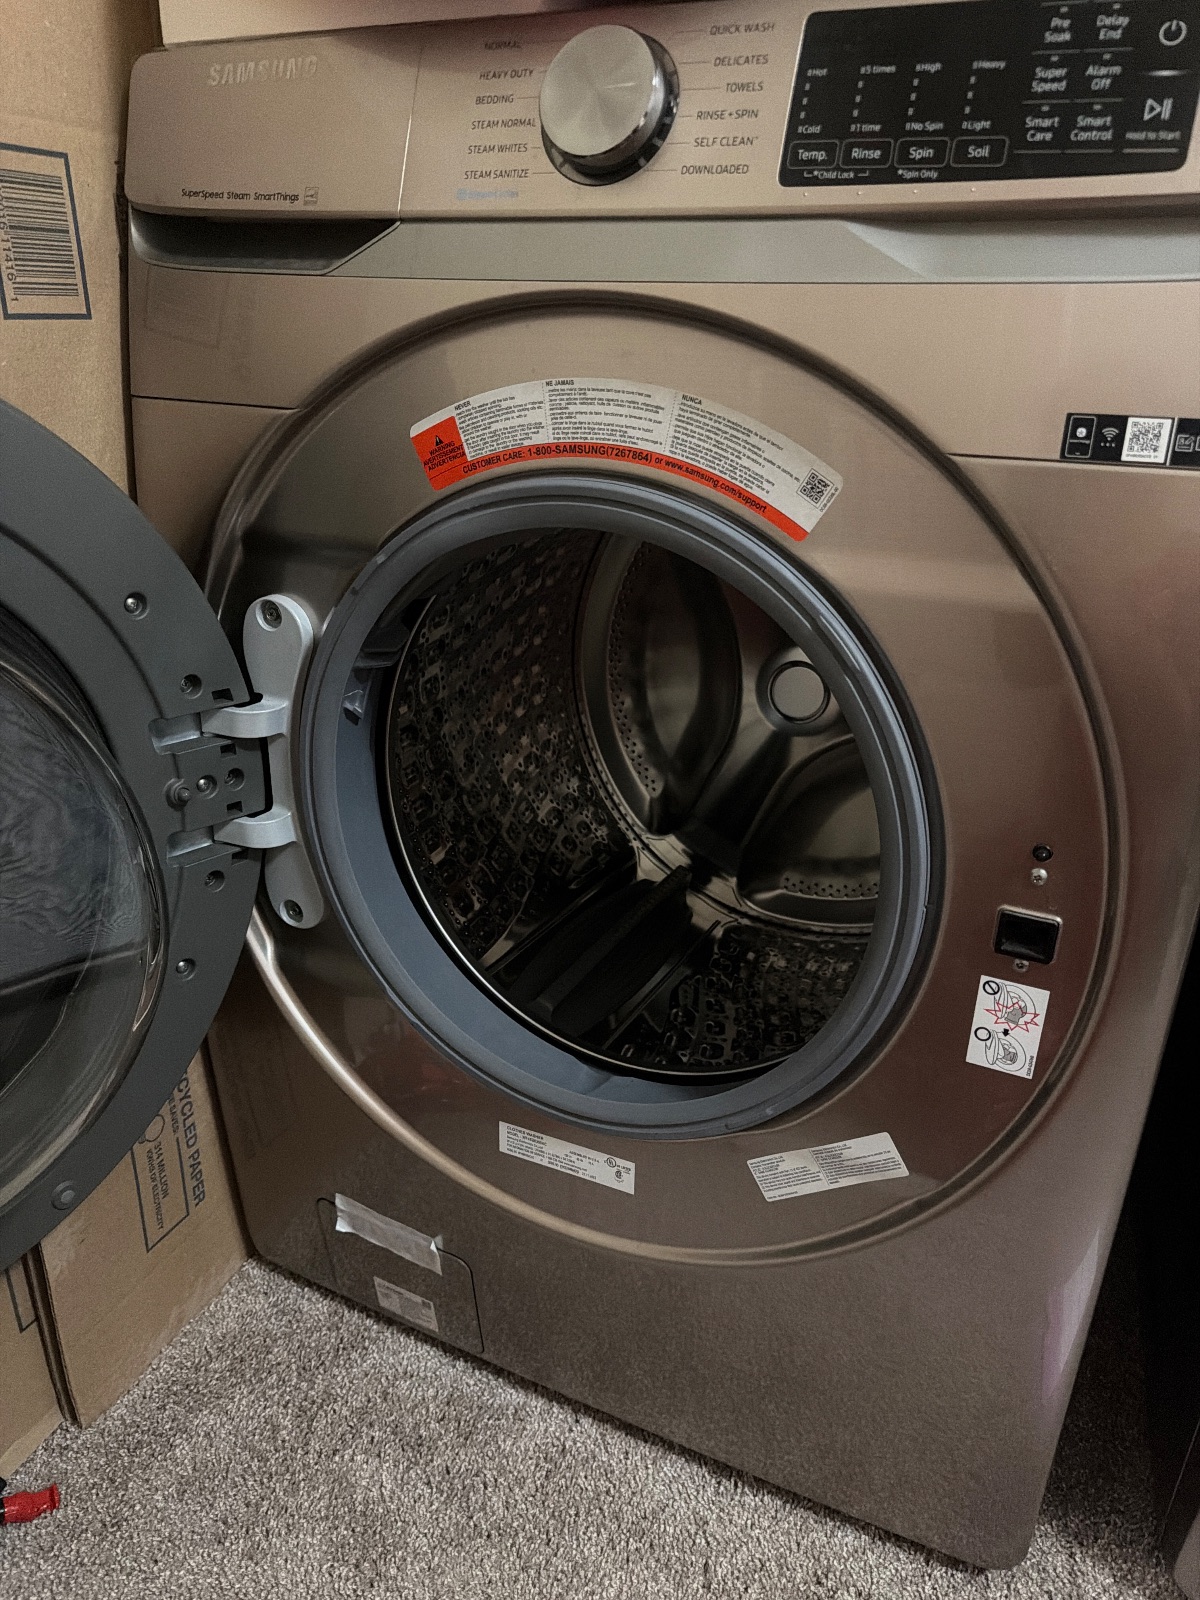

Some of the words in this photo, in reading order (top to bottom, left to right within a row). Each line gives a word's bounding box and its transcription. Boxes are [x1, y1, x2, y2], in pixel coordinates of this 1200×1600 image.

[1050, 17, 1071, 29] Pre
[1096, 14, 1130, 28] Delay
[709, 24, 741, 36] QUICK
[744, 22, 775, 33] WASH
[1099, 27, 1123, 41] End
[1044, 30, 1071, 43] Soak
[484, 41, 521, 51] NORMAL
[713, 53, 769, 67] DELICATES
[479, 70, 508, 80] HEAVY
[509, 68, 534, 79] DUTY
[1034, 66, 1068, 79] Super
[1085, 64, 1122, 76] Alarm
[726, 80, 764, 93] TOWELS
[1031, 79, 1067, 93] Speed
[1090, 77, 1113, 91] Off
[475, 94, 514, 105] BEDDING
[696, 109, 727, 120] RINSE
[734, 109, 759, 120] SPIN
[471, 120, 500, 130] STEAM
[500, 118, 537, 128] NORMAL
[862, 123, 882, 132] time
[911, 122, 923, 131] No
[924, 121, 944, 132] Spin
[967, 120, 992, 132] Light
[1025, 116, 1060, 128] Smart
[1076, 115, 1112, 128] Smart
[802, 125, 821, 134] Cold
[1026, 130, 1054, 142] Care
[1070, 128, 1113, 142] Control
[467, 144, 496, 155] STEAM
[497, 142, 528, 153] WHITES
[693, 137, 719, 148] SELF
[797, 149, 828, 162] Temp.
[851, 147, 882, 160] Rinse
[908, 146, 934, 161] Spin
[967, 144, 991, 158] Soil
[464, 169, 492, 180] STEAM
[493, 168, 530, 179] SANITIZE
[680, 163, 749, 175] DOWNLOADED
[837, 171, 855, 179] Lock
[901, 169, 919, 180] Spin
[920, 169, 939, 179] Only
[181, 188, 225, 200] SuperSpeed
[226, 191, 250, 200] Steam
[253, 192, 300, 204] SmartThings
[553, 379, 575, 387] JAMAIS
[454, 400, 472, 411] NEVER
[681, 393, 703, 406] NUNCA
[428, 440, 455, 457] WARNING
[462, 454, 502, 474] CUSTOMER
[502, 450, 525, 463] CARE:
[527, 444, 652, 464] 1-800-SAMSUNG(7267864)
[654, 456, 663, 464] or
[664, 459, 767, 513] www.samsung.com/support
[177, 1072, 197, 1149] CYCLED
[188, 1148, 206, 1208] PAPER
[154, 1141, 163, 1158] 314
[156, 1157, 170, 1200] MILLION
